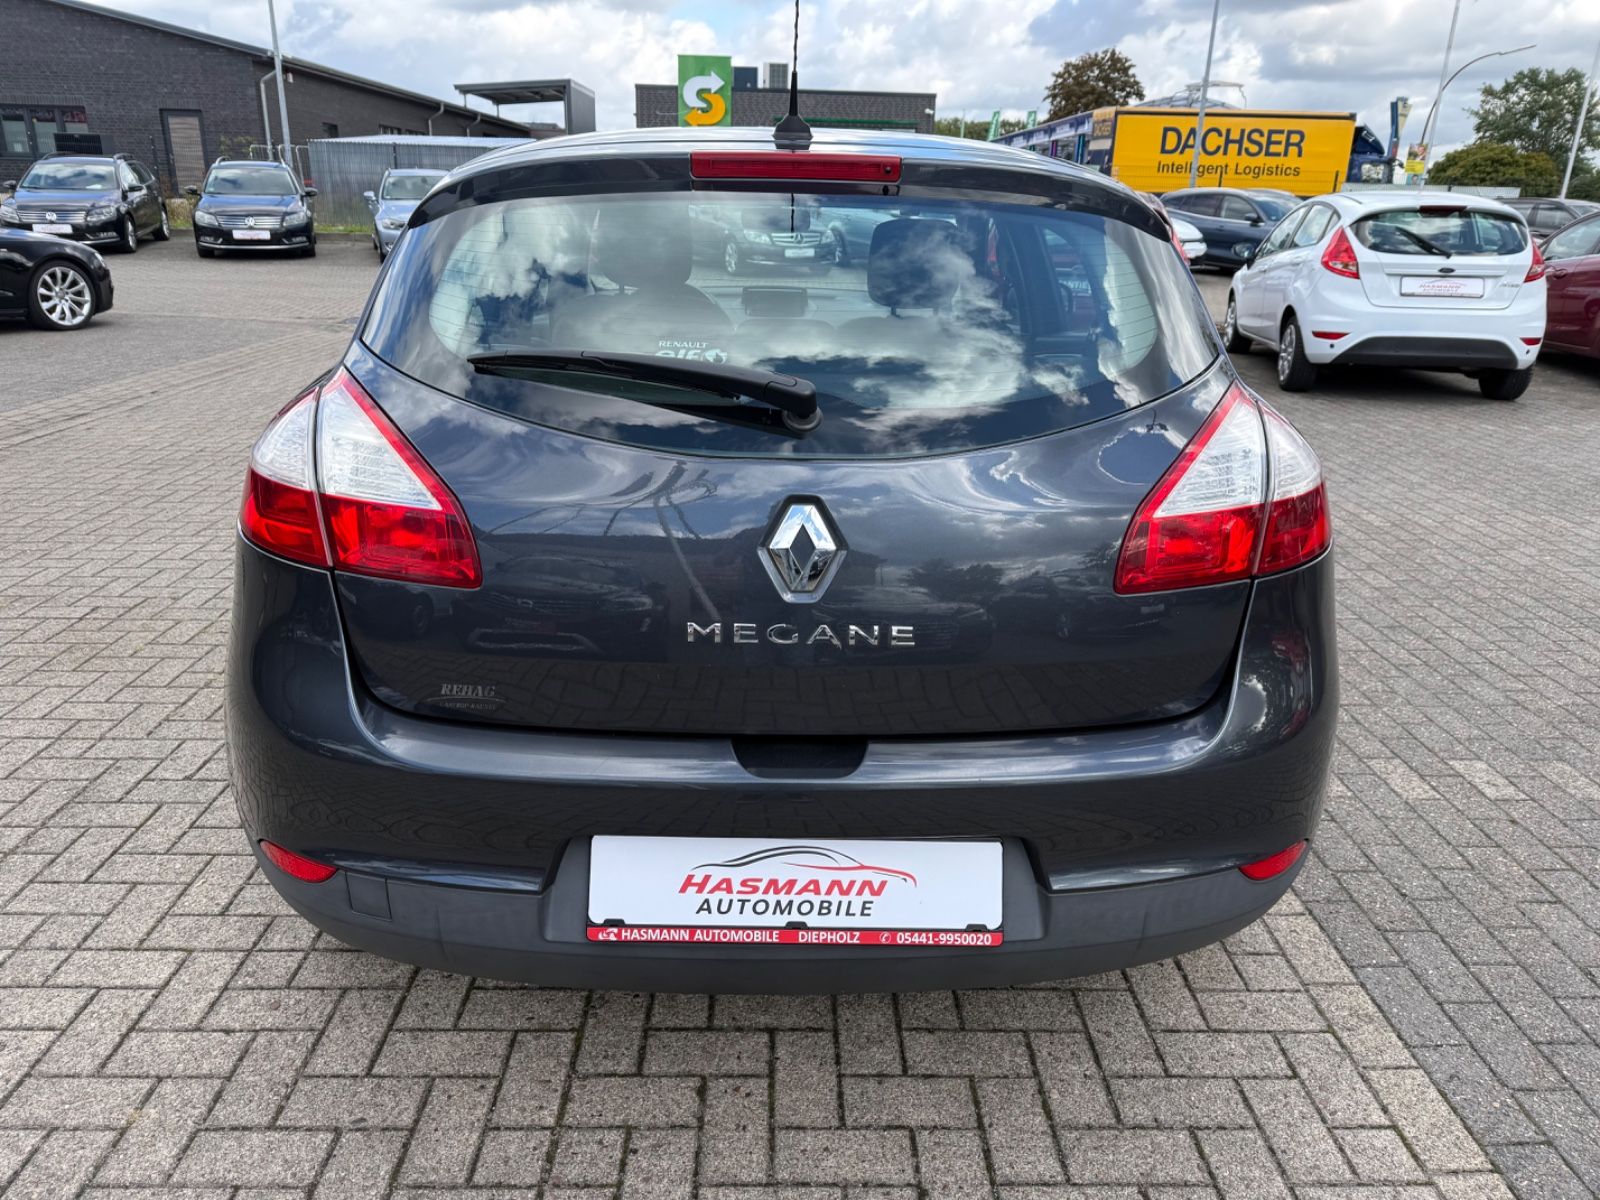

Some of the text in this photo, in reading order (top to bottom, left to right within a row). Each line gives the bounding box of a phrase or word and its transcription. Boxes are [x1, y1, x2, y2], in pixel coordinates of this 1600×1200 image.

[1160, 126, 1305, 158] DACHSER
[1157, 160, 1301, 179] Intellgent Logistics
[658, 340, 708, 349] RENAULT
[686, 621, 915, 648] MEGANE
[440, 683, 496, 697] REHAG
[678, 874, 888, 897] HASMANN
[695, 898, 874, 917] AUTOMOBILE
[621, 928, 992, 946] HASMANN AUTOMOBILE DIEPHOLZ 05441-9950020
